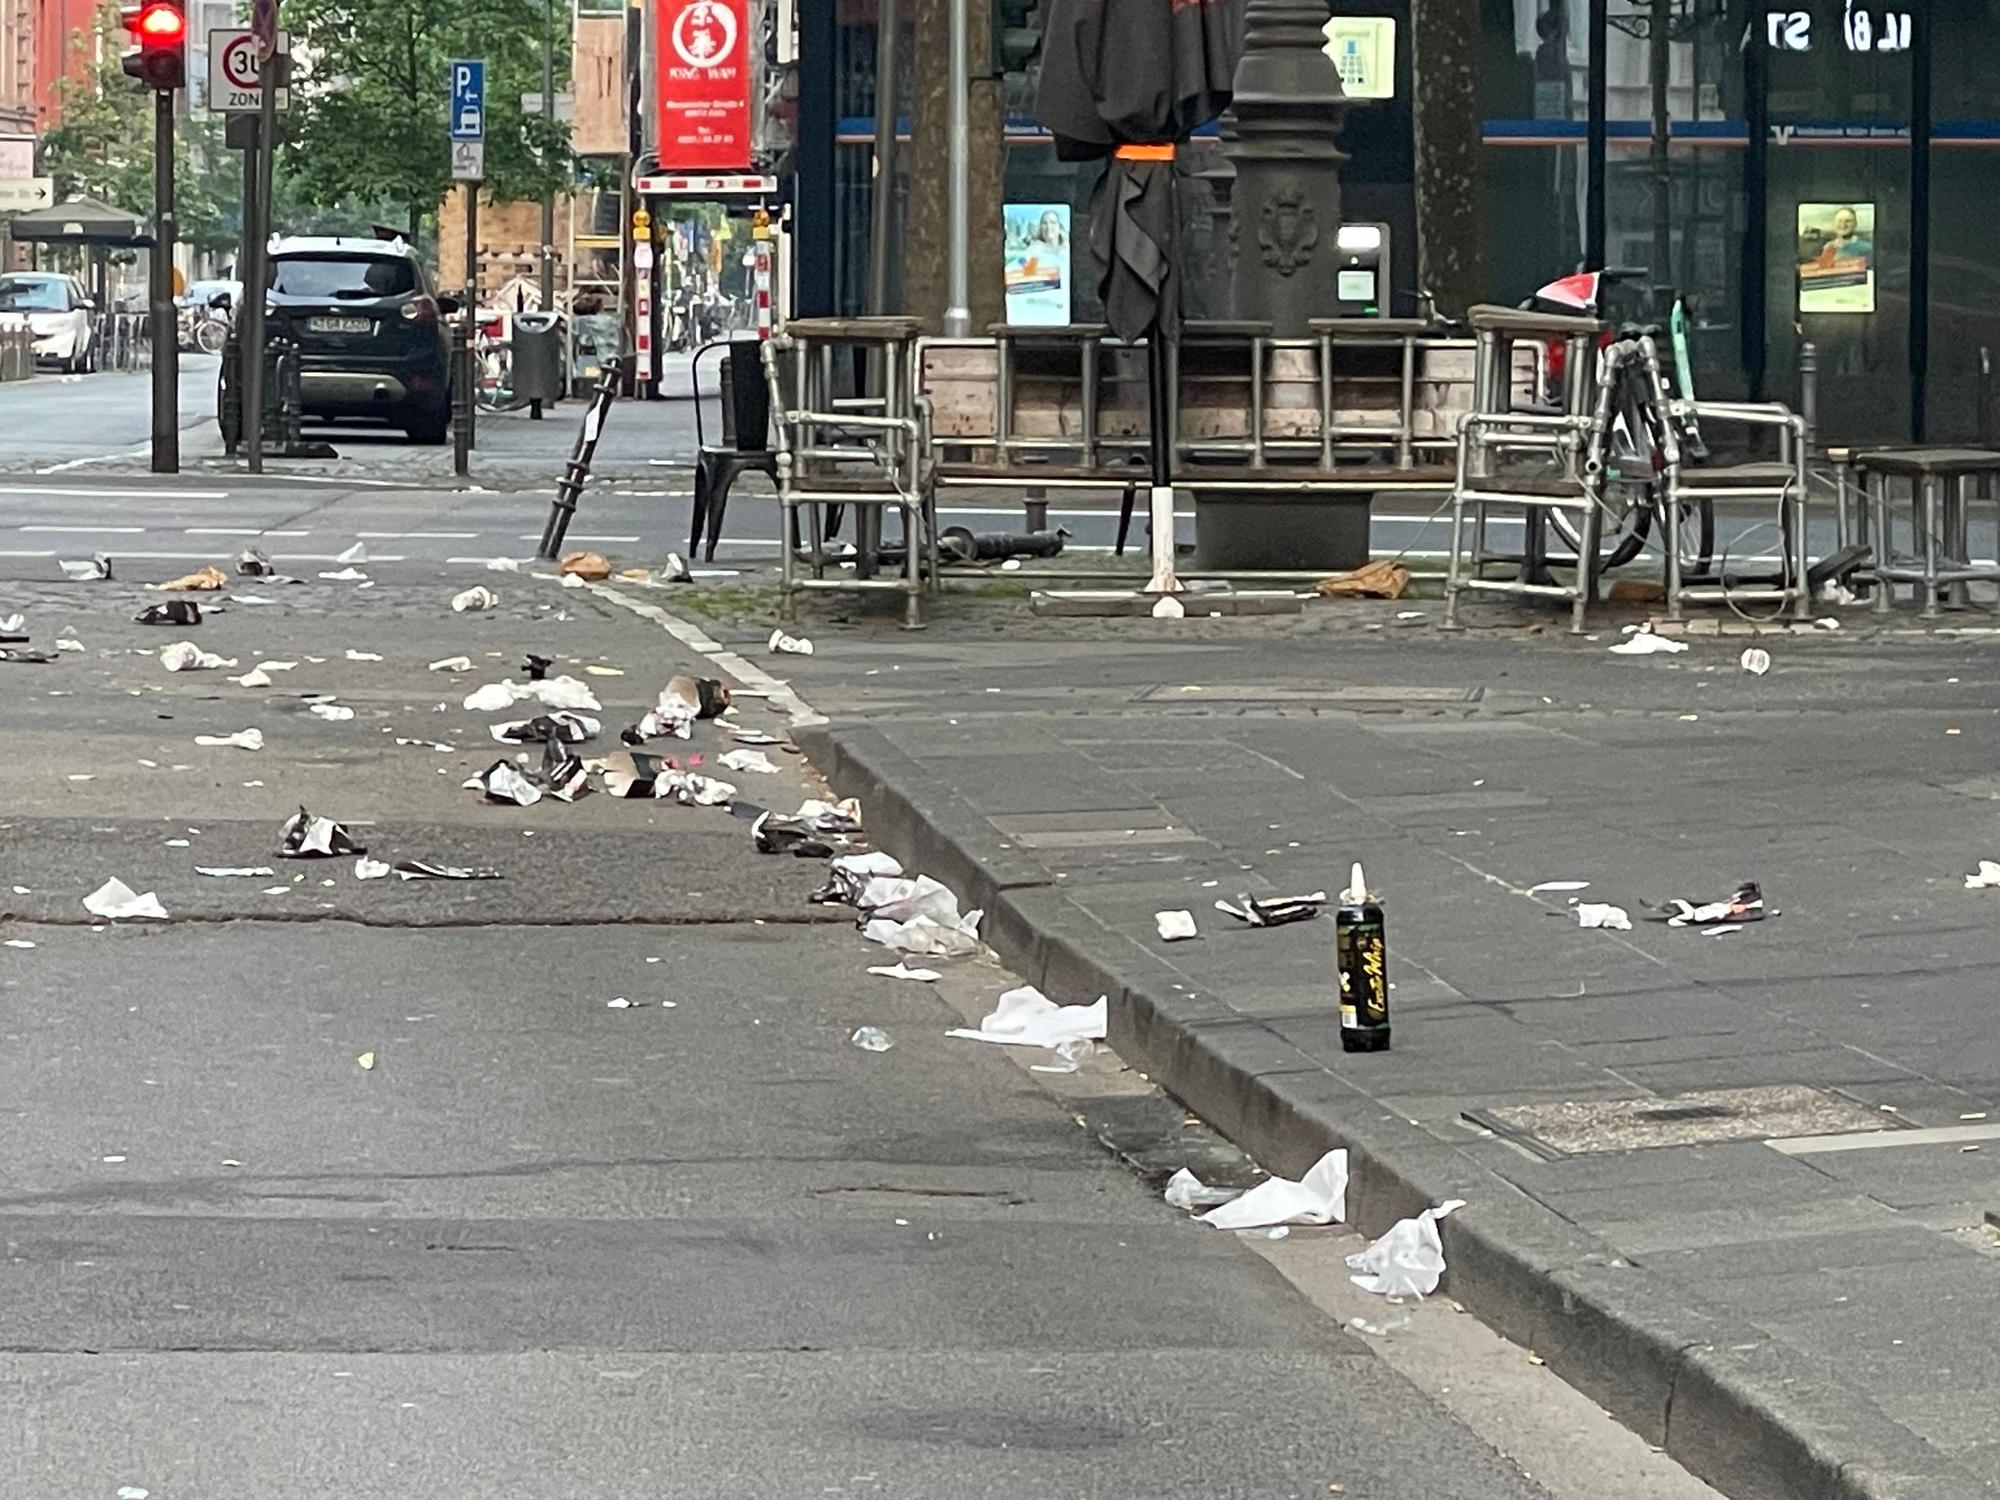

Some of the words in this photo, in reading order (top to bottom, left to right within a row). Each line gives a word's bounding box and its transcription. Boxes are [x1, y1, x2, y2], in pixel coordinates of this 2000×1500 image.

[456, 66, 471, 97] P
[228, 92, 260, 106] ZON
[1362, 938, 1384, 975] Whip
